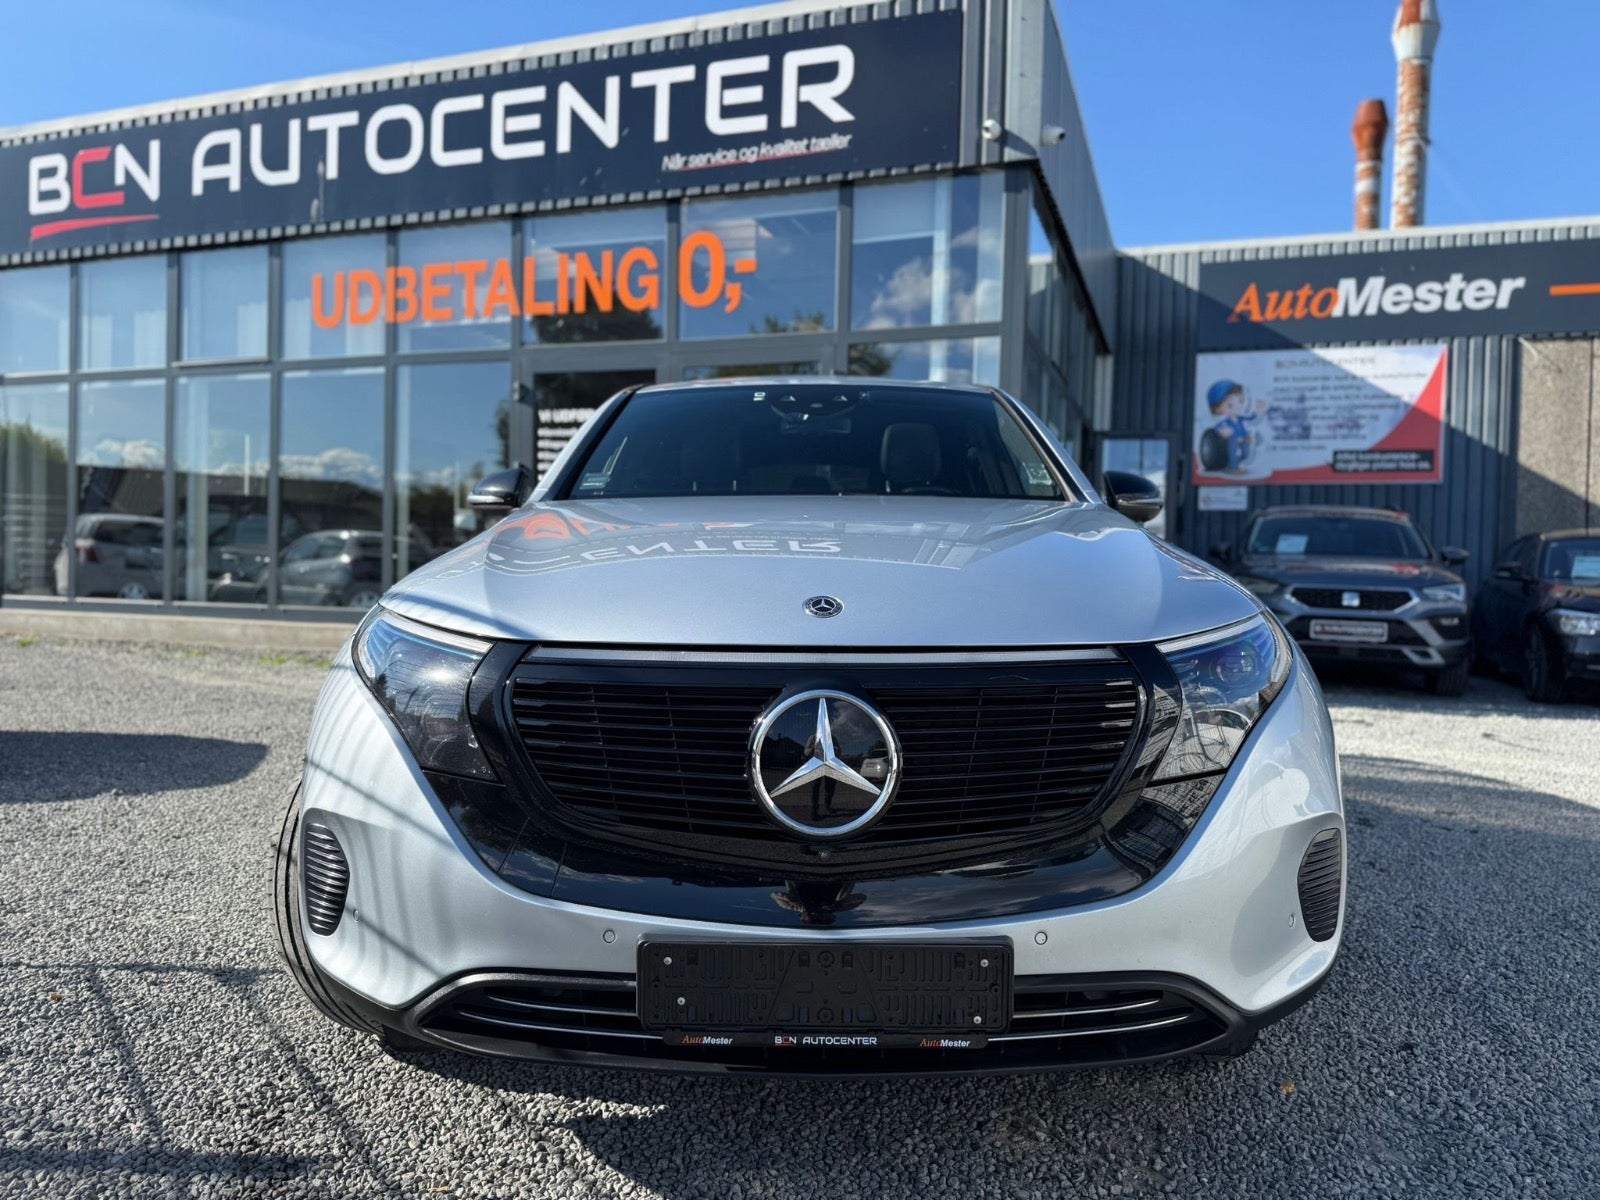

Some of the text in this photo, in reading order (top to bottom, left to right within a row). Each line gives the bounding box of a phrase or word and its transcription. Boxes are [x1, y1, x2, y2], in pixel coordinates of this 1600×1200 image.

[28, 44, 855, 216] BCN AUTOCENTER
[687, 148, 738, 168] service
[738, 145, 760, 164] og
[760, 138, 808, 158] kvalitet
[311, 247, 661, 329] UDBETALING
[774, 1035, 797, 1045] BCN
[803, 1036, 878, 1046] AUTOCENTER
